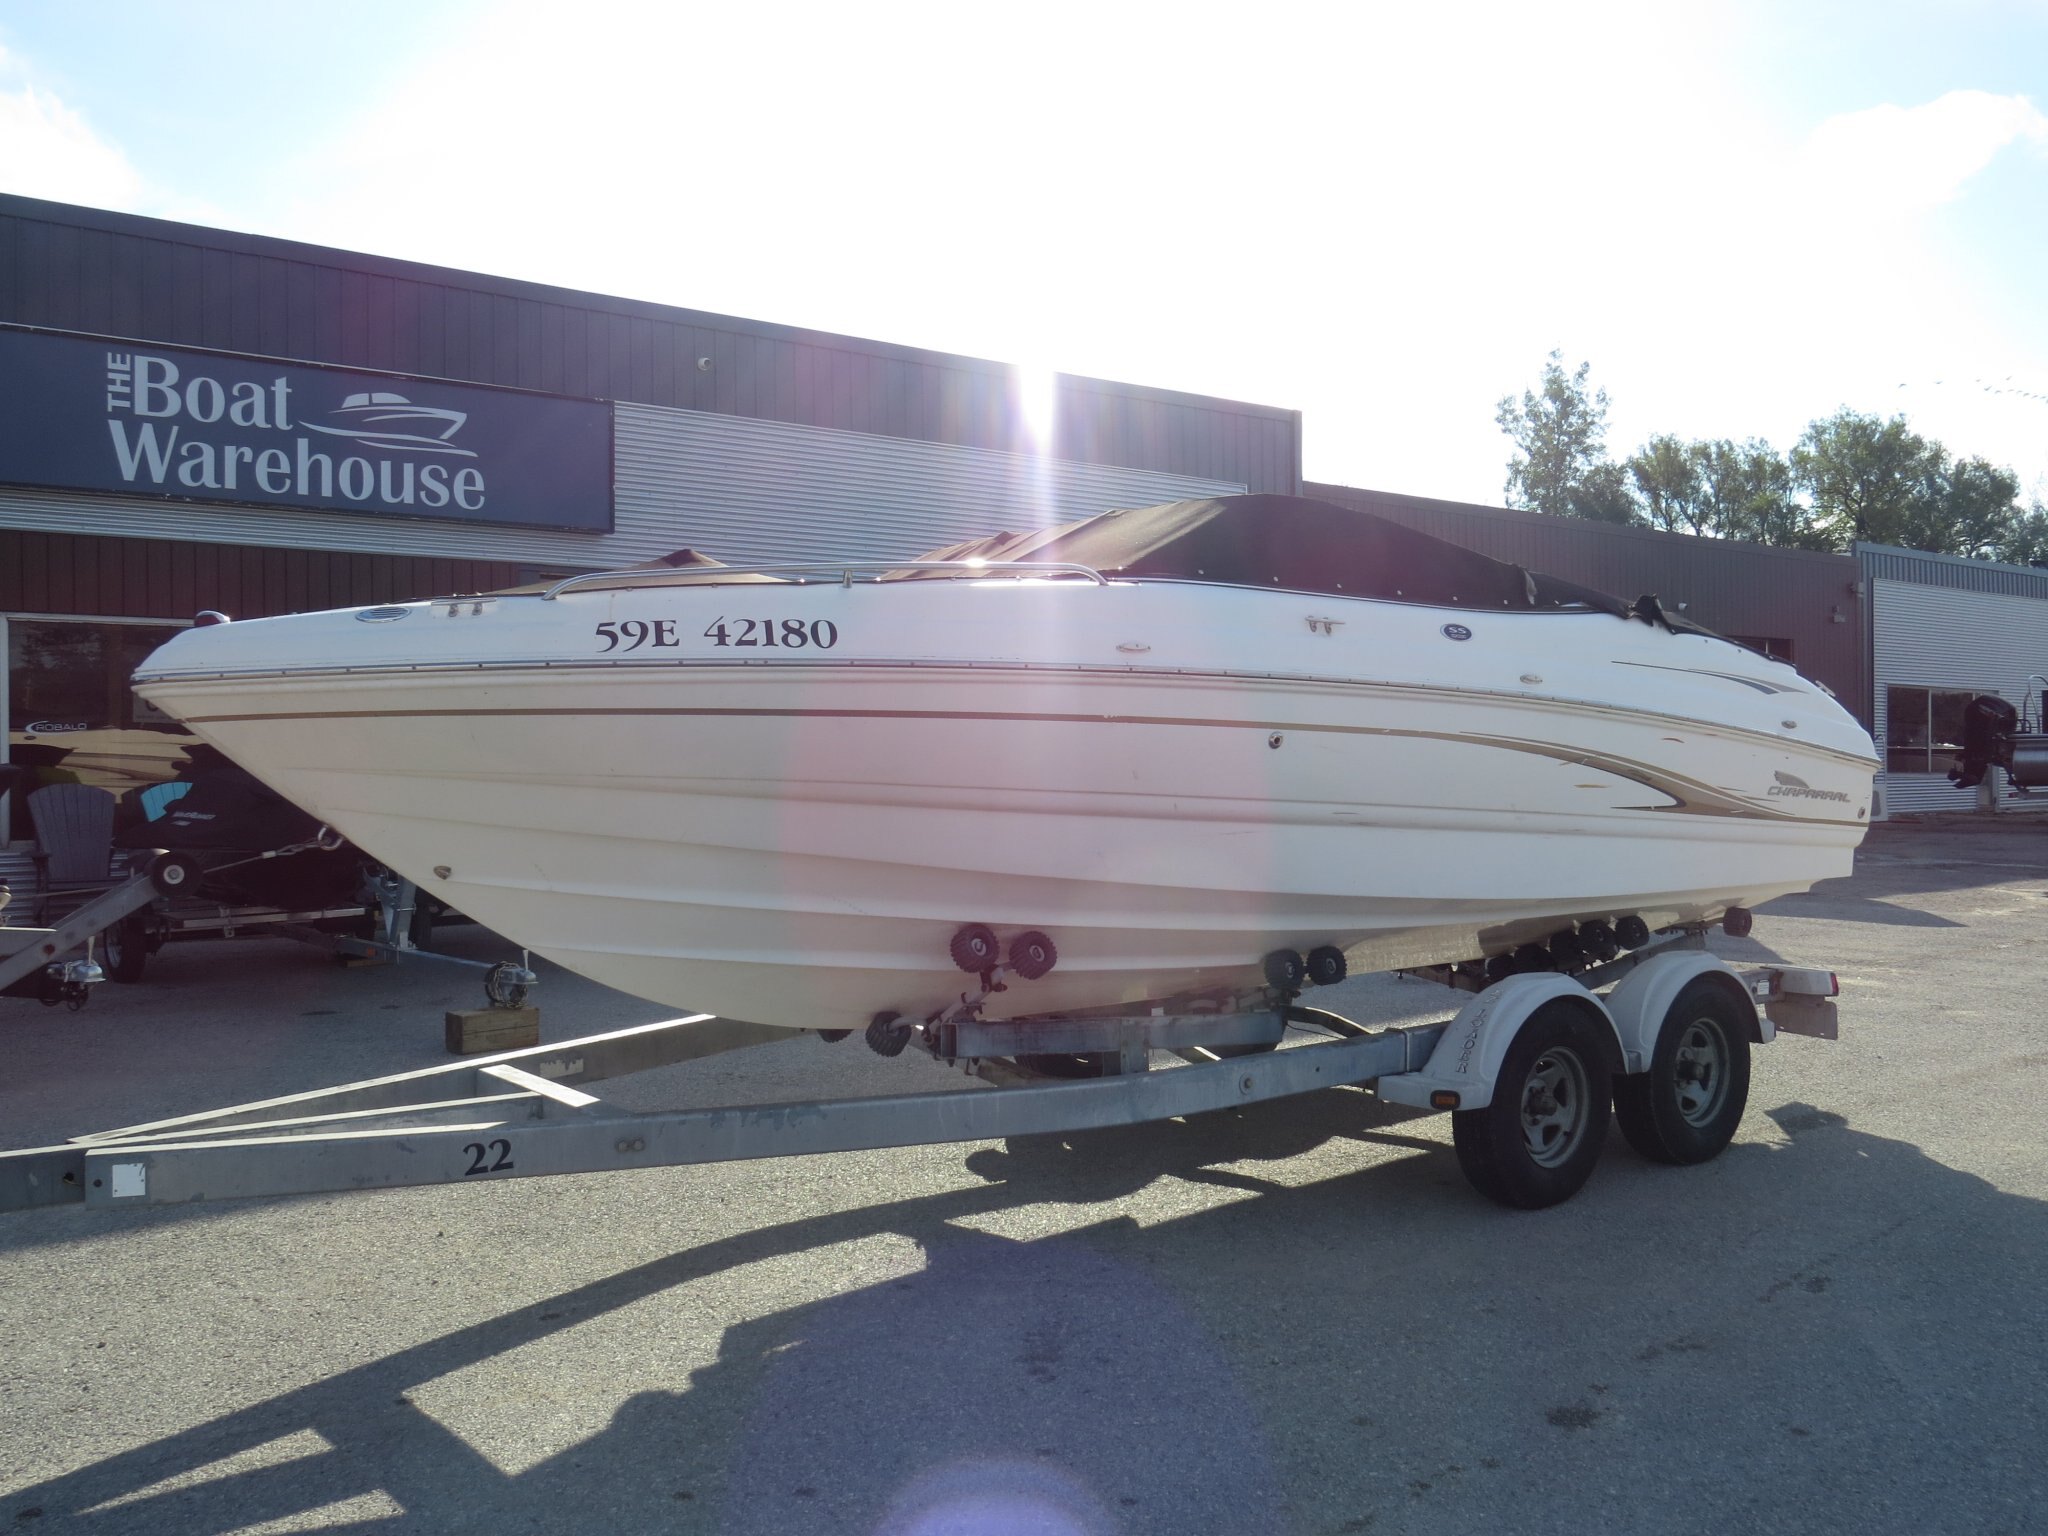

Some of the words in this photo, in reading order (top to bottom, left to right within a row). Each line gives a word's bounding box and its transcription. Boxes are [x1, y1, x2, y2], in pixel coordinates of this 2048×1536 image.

[107, 352, 131, 412] THE
[134, 355, 293, 431] Boat
[108, 419, 485, 510] Warehouse
[595, 620, 680, 653] 59E
[703, 615, 838, 649] 42180
[36, 722, 87, 731] ROBALO
[1767, 786, 1851, 803] CHAPARRAL
[1456, 1009, 1487, 1074] LOADER
[463, 1138, 514, 1177] 22
